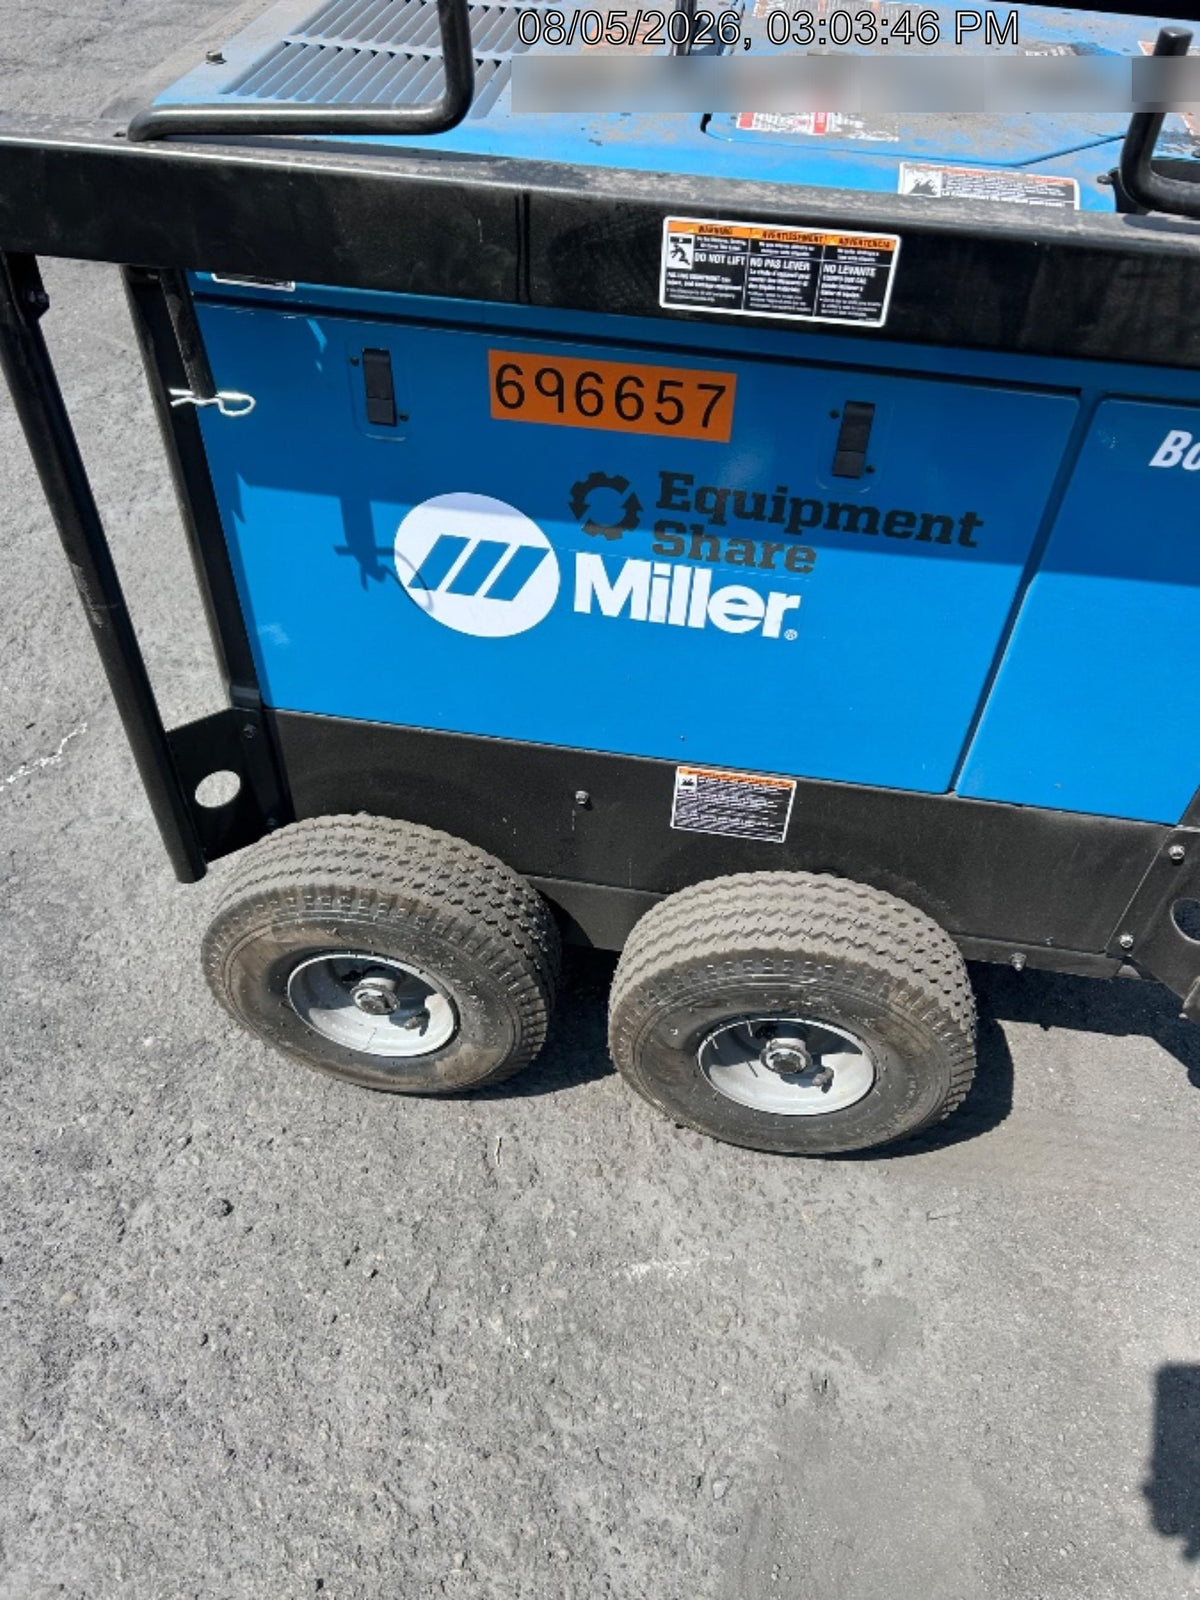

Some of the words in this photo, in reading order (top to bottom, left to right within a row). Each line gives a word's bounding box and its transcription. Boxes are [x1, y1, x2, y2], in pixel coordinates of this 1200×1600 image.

[694, 252, 706, 263] DO
[708, 254, 726, 264] NOT
[727, 255, 746, 266] LIFT
[823, 263, 836, 274] NO
[495, 363, 727, 428] 696657
[655, 470, 985, 548] Equipment
[651, 519, 817, 575] Share
[573, 551, 801, 640] Miller
